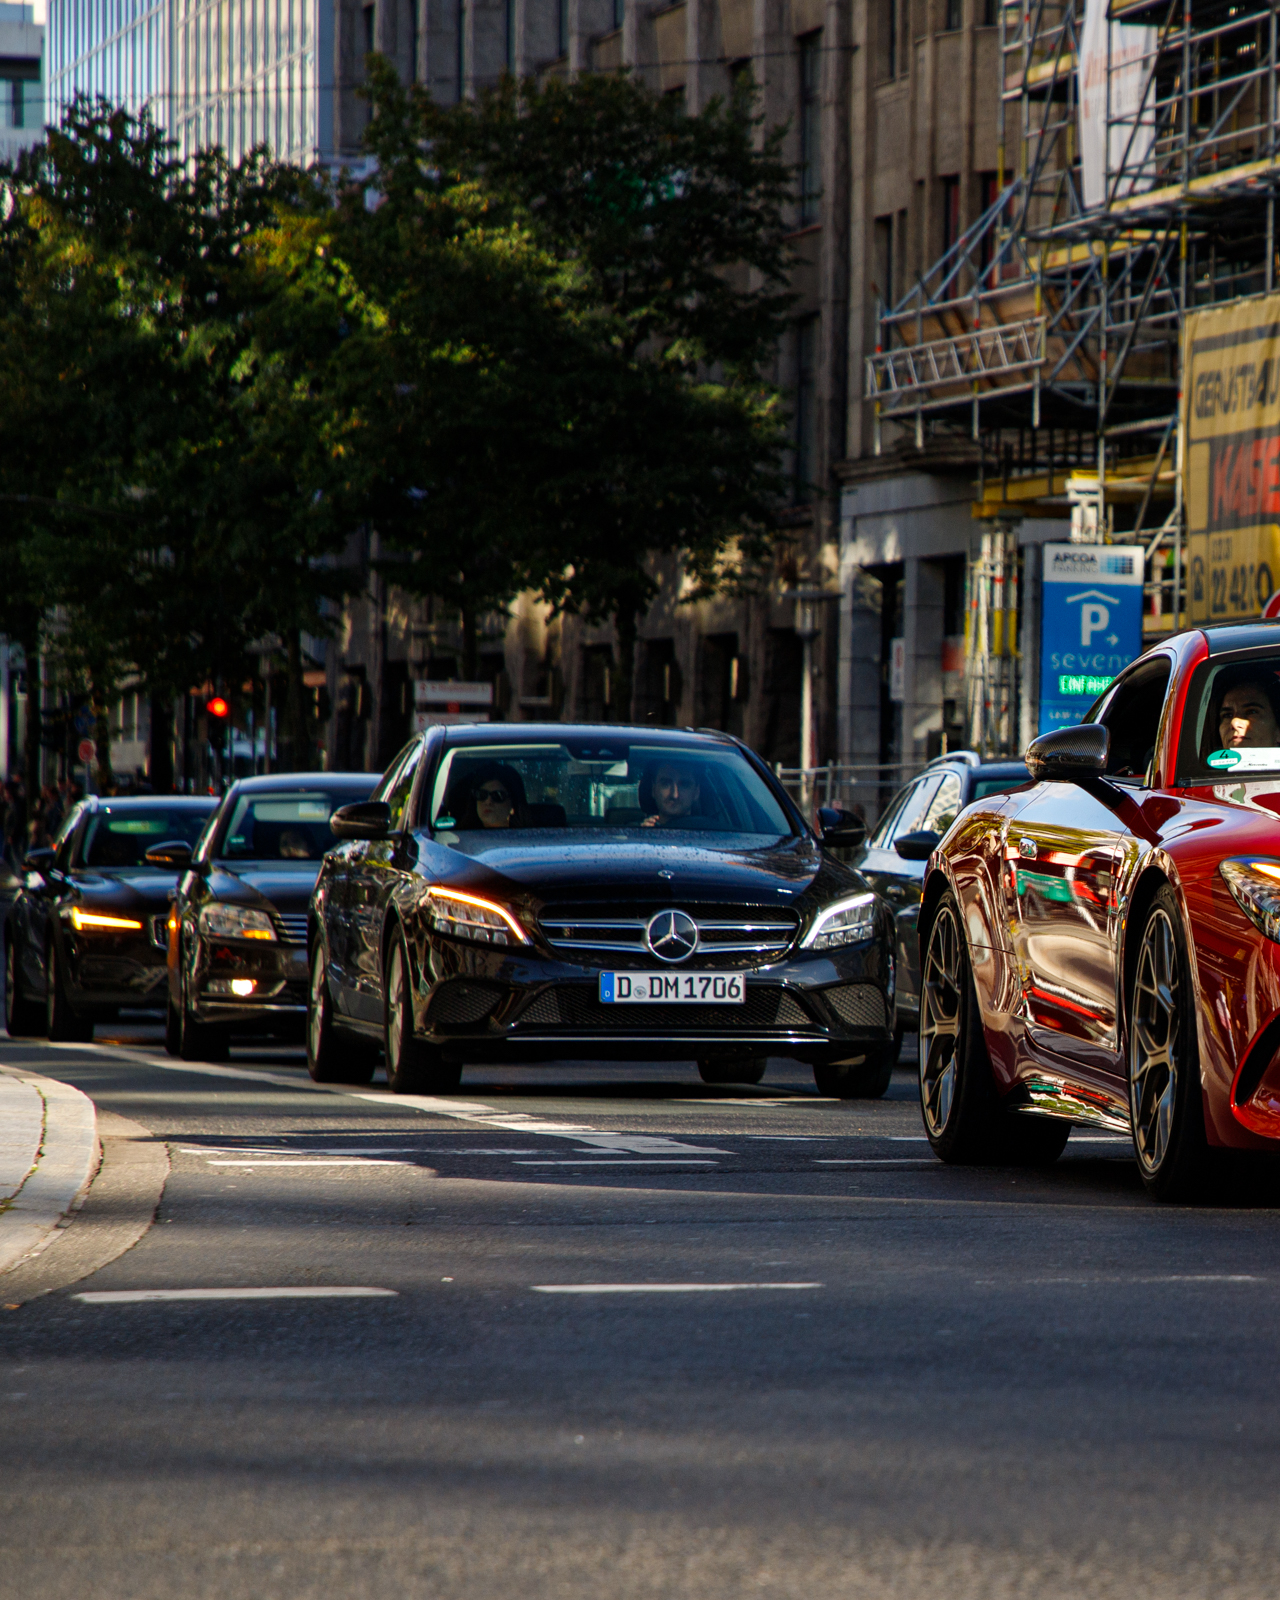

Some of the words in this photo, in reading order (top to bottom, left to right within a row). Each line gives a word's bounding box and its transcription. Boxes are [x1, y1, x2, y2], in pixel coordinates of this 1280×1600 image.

[1053, 552, 1098, 563] APCOA
[1052, 562, 1099, 574] PARKING
[1080, 603, 1110, 647] P
[1219, 750, 1229, 759] 4
[617, 976, 632, 998] D
[649, 976, 679, 998] DM
[684, 976, 741, 999] 1706
